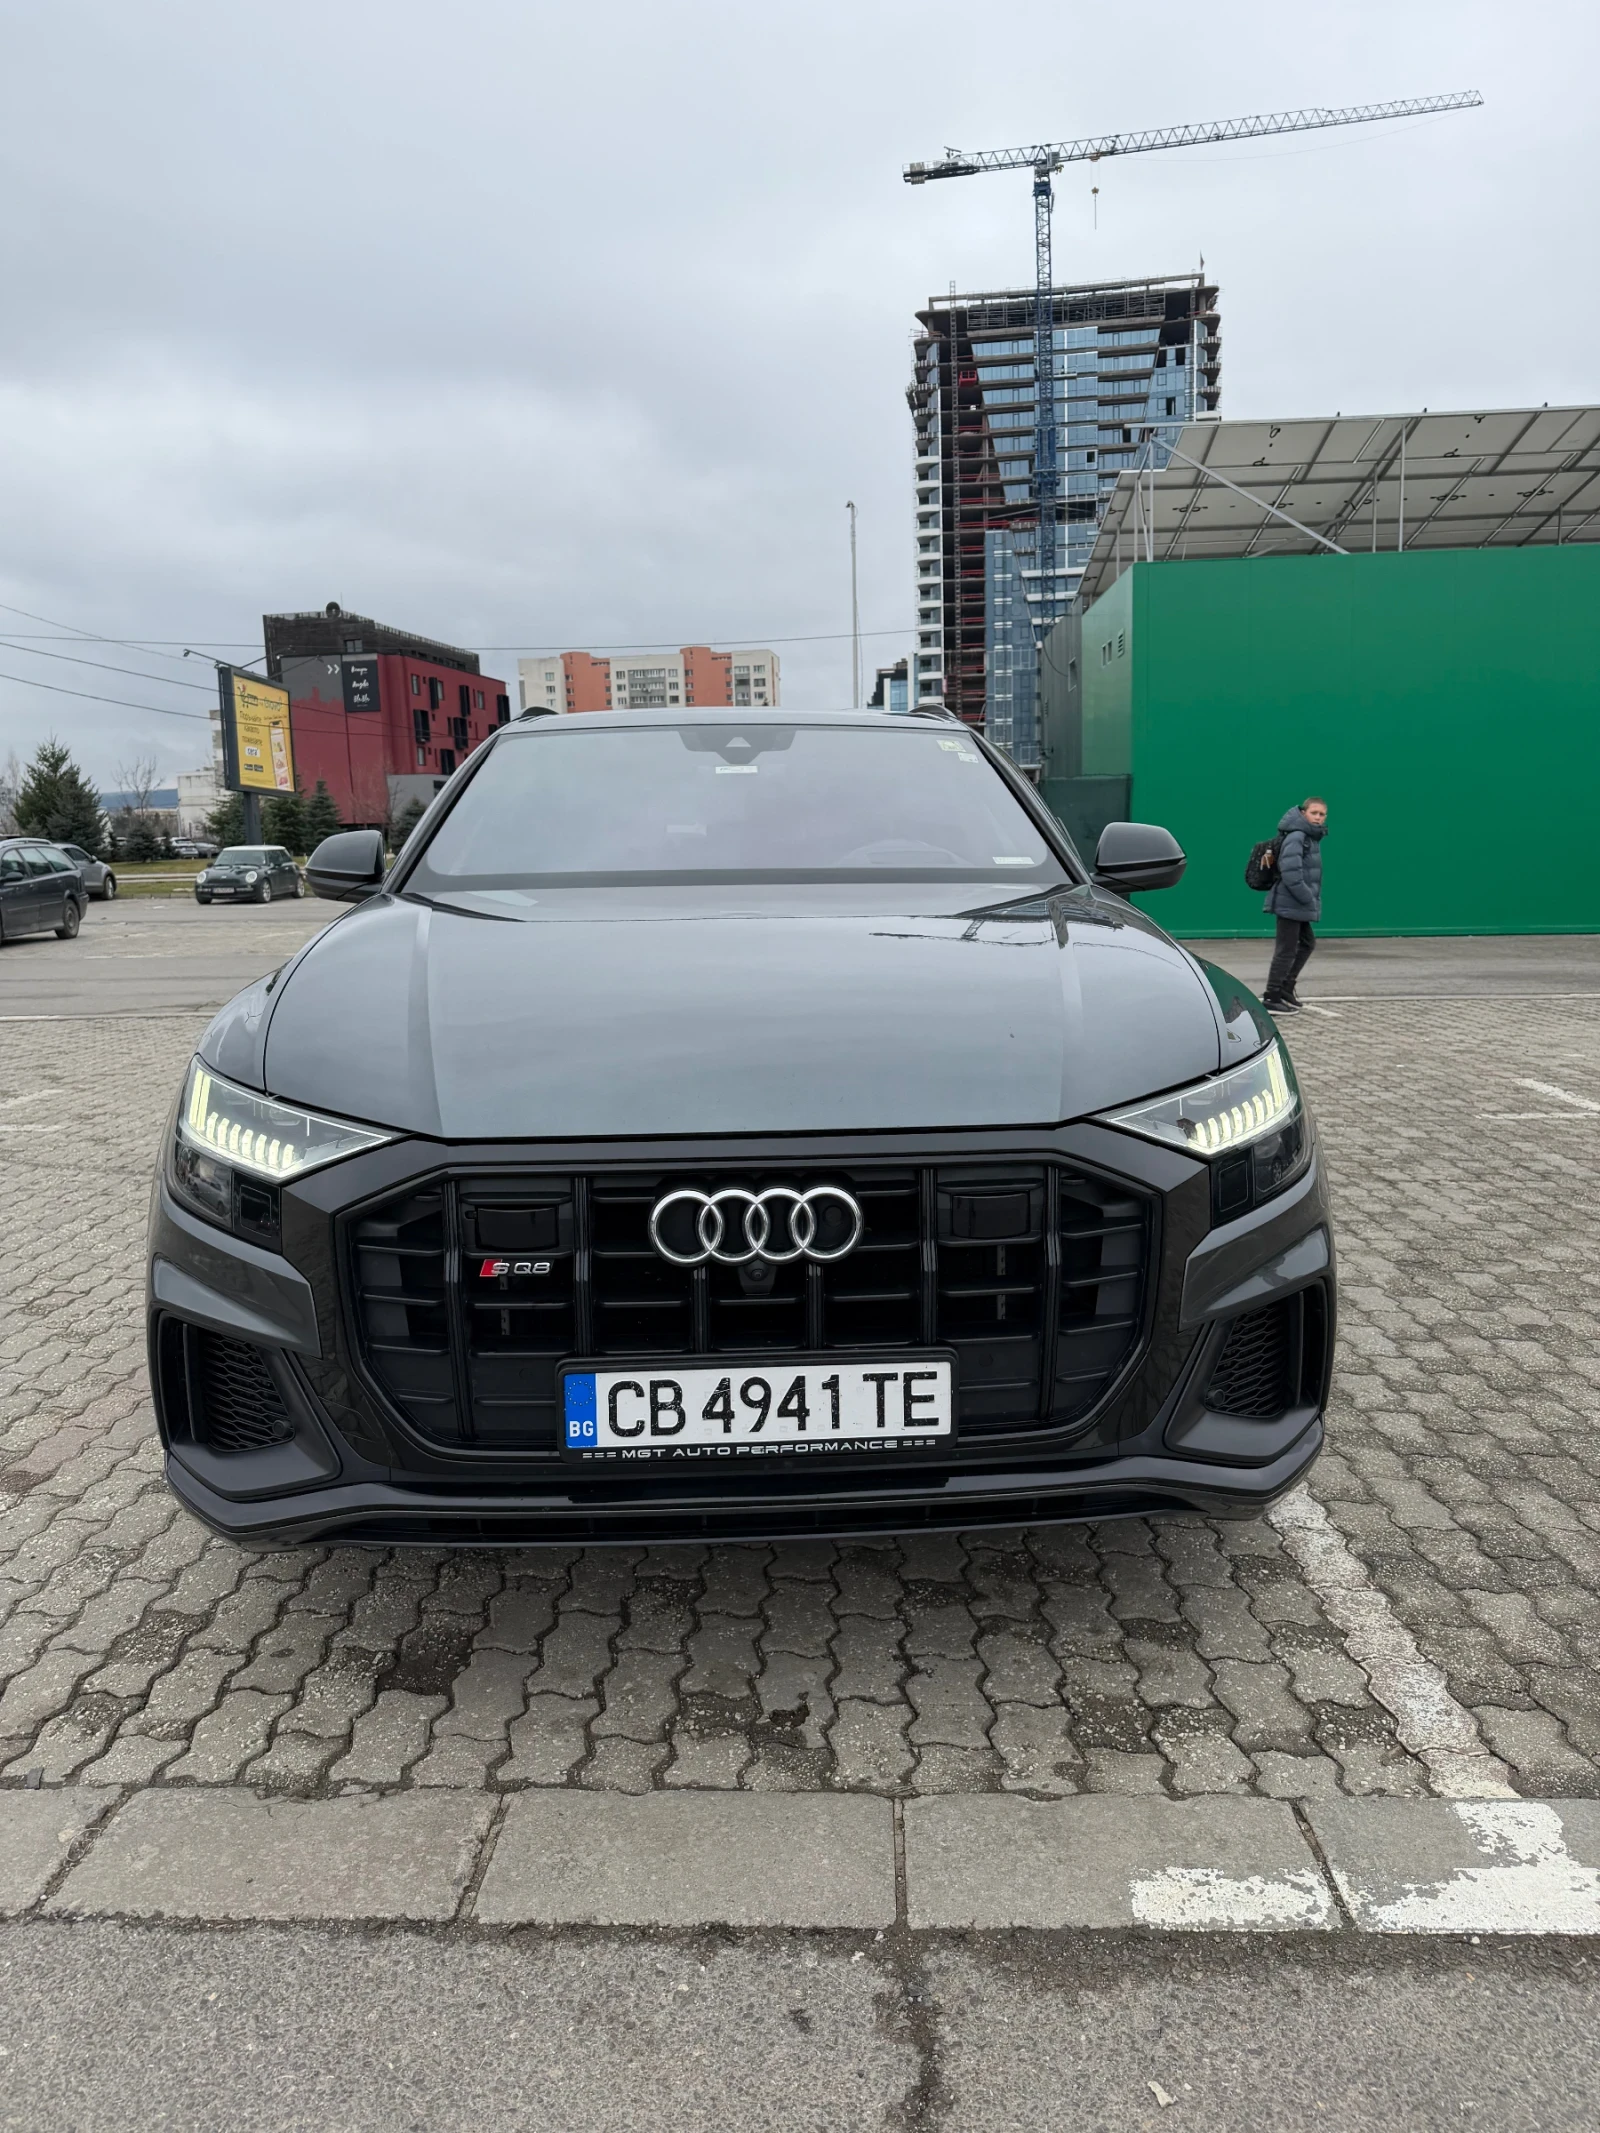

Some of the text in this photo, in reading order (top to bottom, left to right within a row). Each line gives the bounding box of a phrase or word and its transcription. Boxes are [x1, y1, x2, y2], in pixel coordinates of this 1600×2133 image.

[608, 1371, 940, 1438] CB 4941 TE
[569, 1420, 594, 1438] BG
[622, 1439, 899, 1459] MGT AUTO PERFORMANCE
